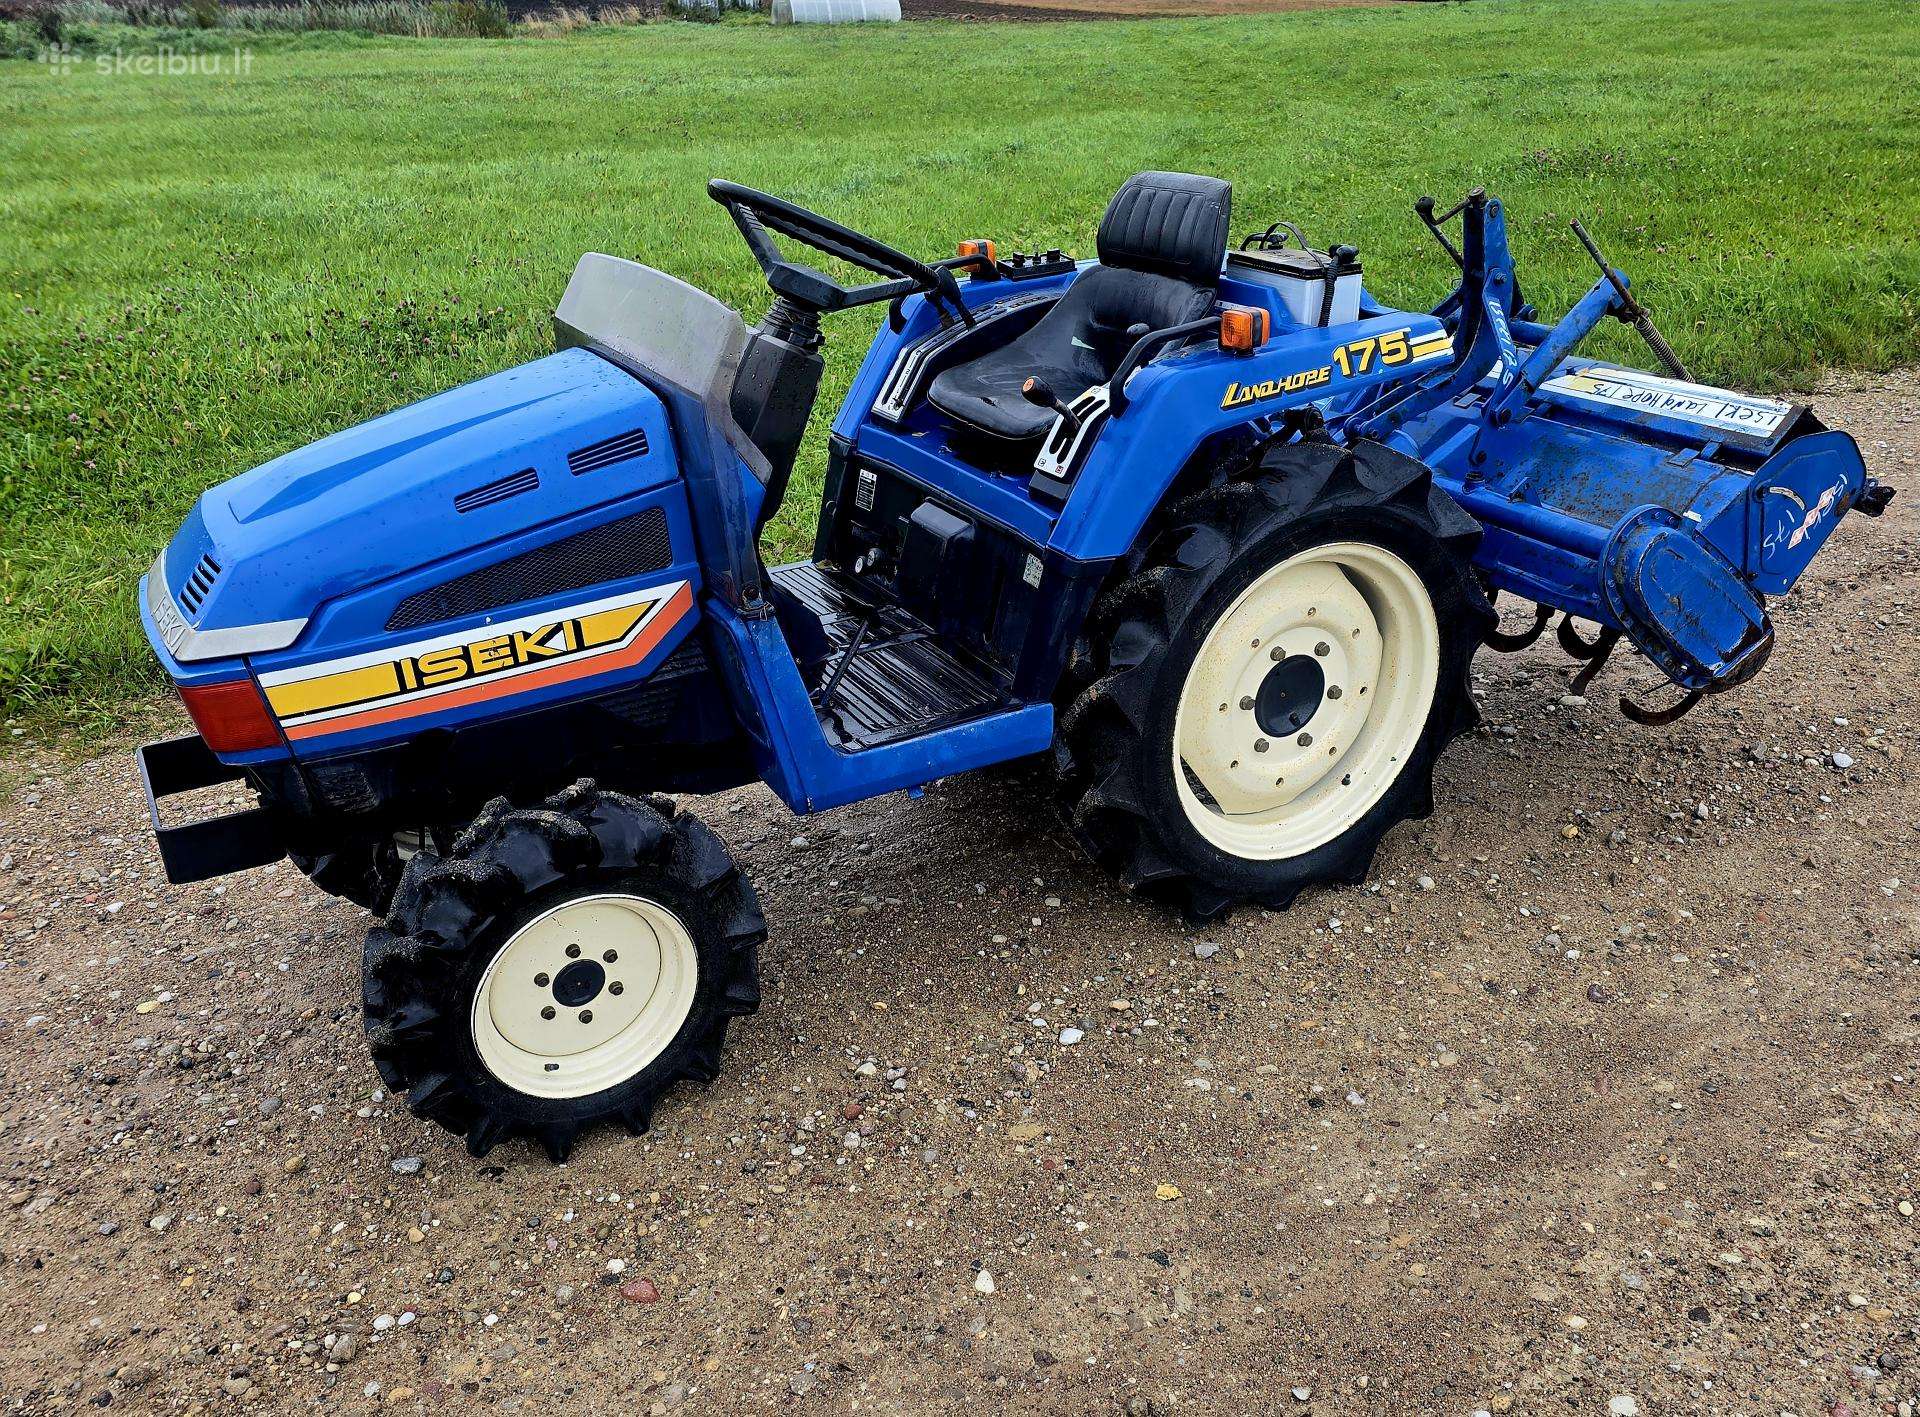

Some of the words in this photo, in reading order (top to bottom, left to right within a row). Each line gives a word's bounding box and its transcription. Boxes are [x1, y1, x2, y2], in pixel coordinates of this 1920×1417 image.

[1221, 366, 1332, 410] LANDHOPE
[1331, 331, 1410, 377] 175
[152, 593, 188, 656] ISEKI
[400, 618, 577, 690] ISEKI
